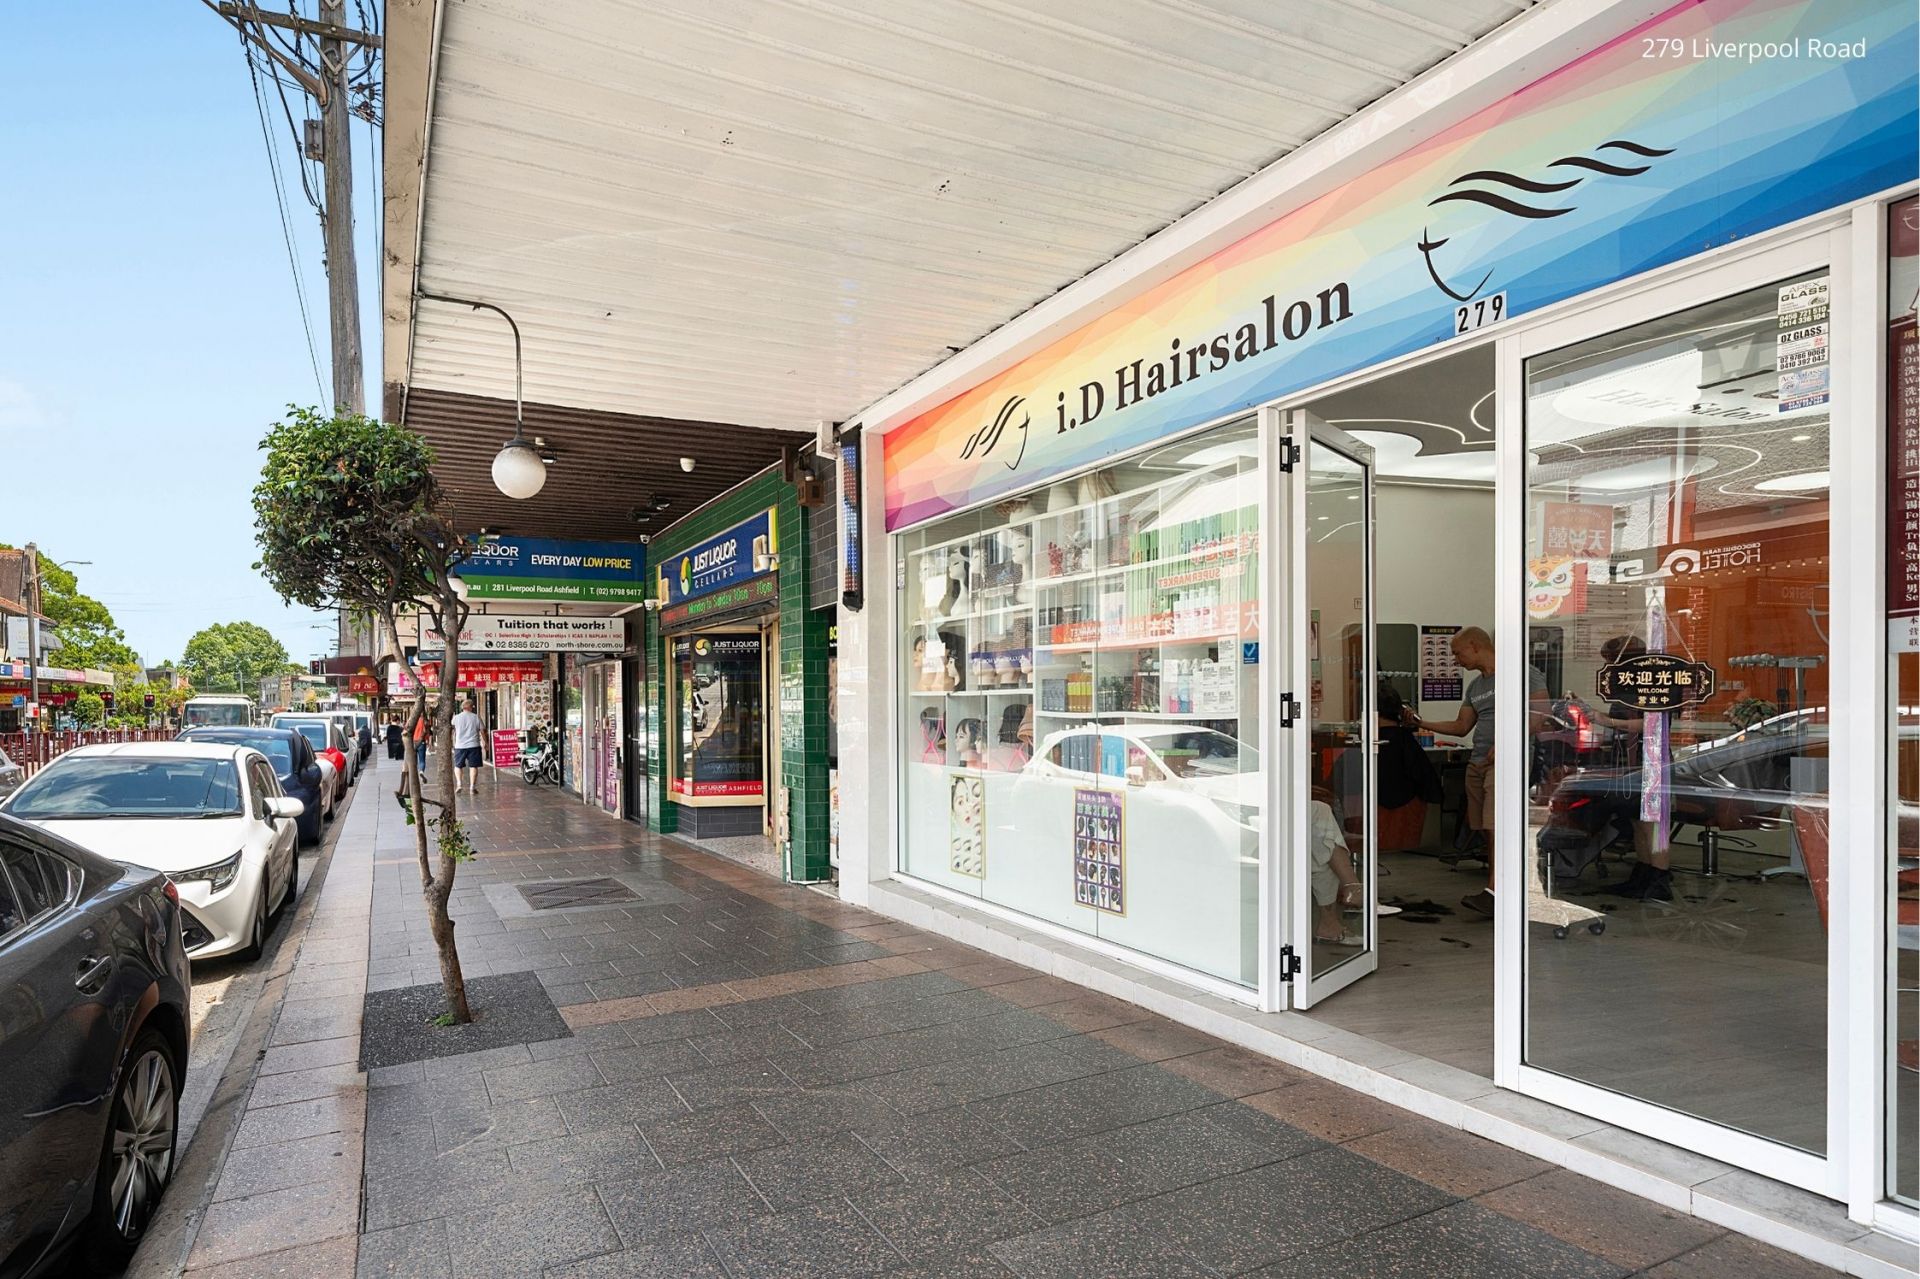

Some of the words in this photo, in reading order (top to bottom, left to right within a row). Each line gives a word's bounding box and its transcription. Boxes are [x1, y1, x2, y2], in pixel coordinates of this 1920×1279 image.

[1781, 285, 1828, 302] GLASS
[1788, 281, 1821, 293] APEX
[1458, 295, 1503, 333] 279
[1780, 333, 1792, 343] OZ
[1793, 326, 1822, 341] GLASS
[1056, 380, 1105, 434] i.D
[1114, 281, 1354, 411] Hairsalon
[1780, 355, 1789, 365] 02
[531, 554, 562, 566] EVERY
[563, 556, 582, 567] DAY
[583, 557, 603, 568] LOW
[604, 558, 632, 570] PRICE
[692, 550, 710, 573] JUST
[708, 538, 737, 566] LIQUOR
[694, 567, 735, 589] CELLARS
[506, 584, 536, 593] Liverpool
[536, 585, 553, 593] Road
[553, 586, 580, 594] Ashfield
[596, 587, 609, 596] (02)
[609, 588, 625, 596] 9798
[625, 588, 642, 596] 9417
[497, 619, 540, 629] Tuition
[543, 620, 569, 629] that
[571, 620, 606, 630] works
[529, 641, 550, 649] 6270
[556, 641, 624, 649] north-shore.com.au
[1617, 669, 1693, 686] 欢迎光临
[1637, 695, 1670, 705] 营业中
